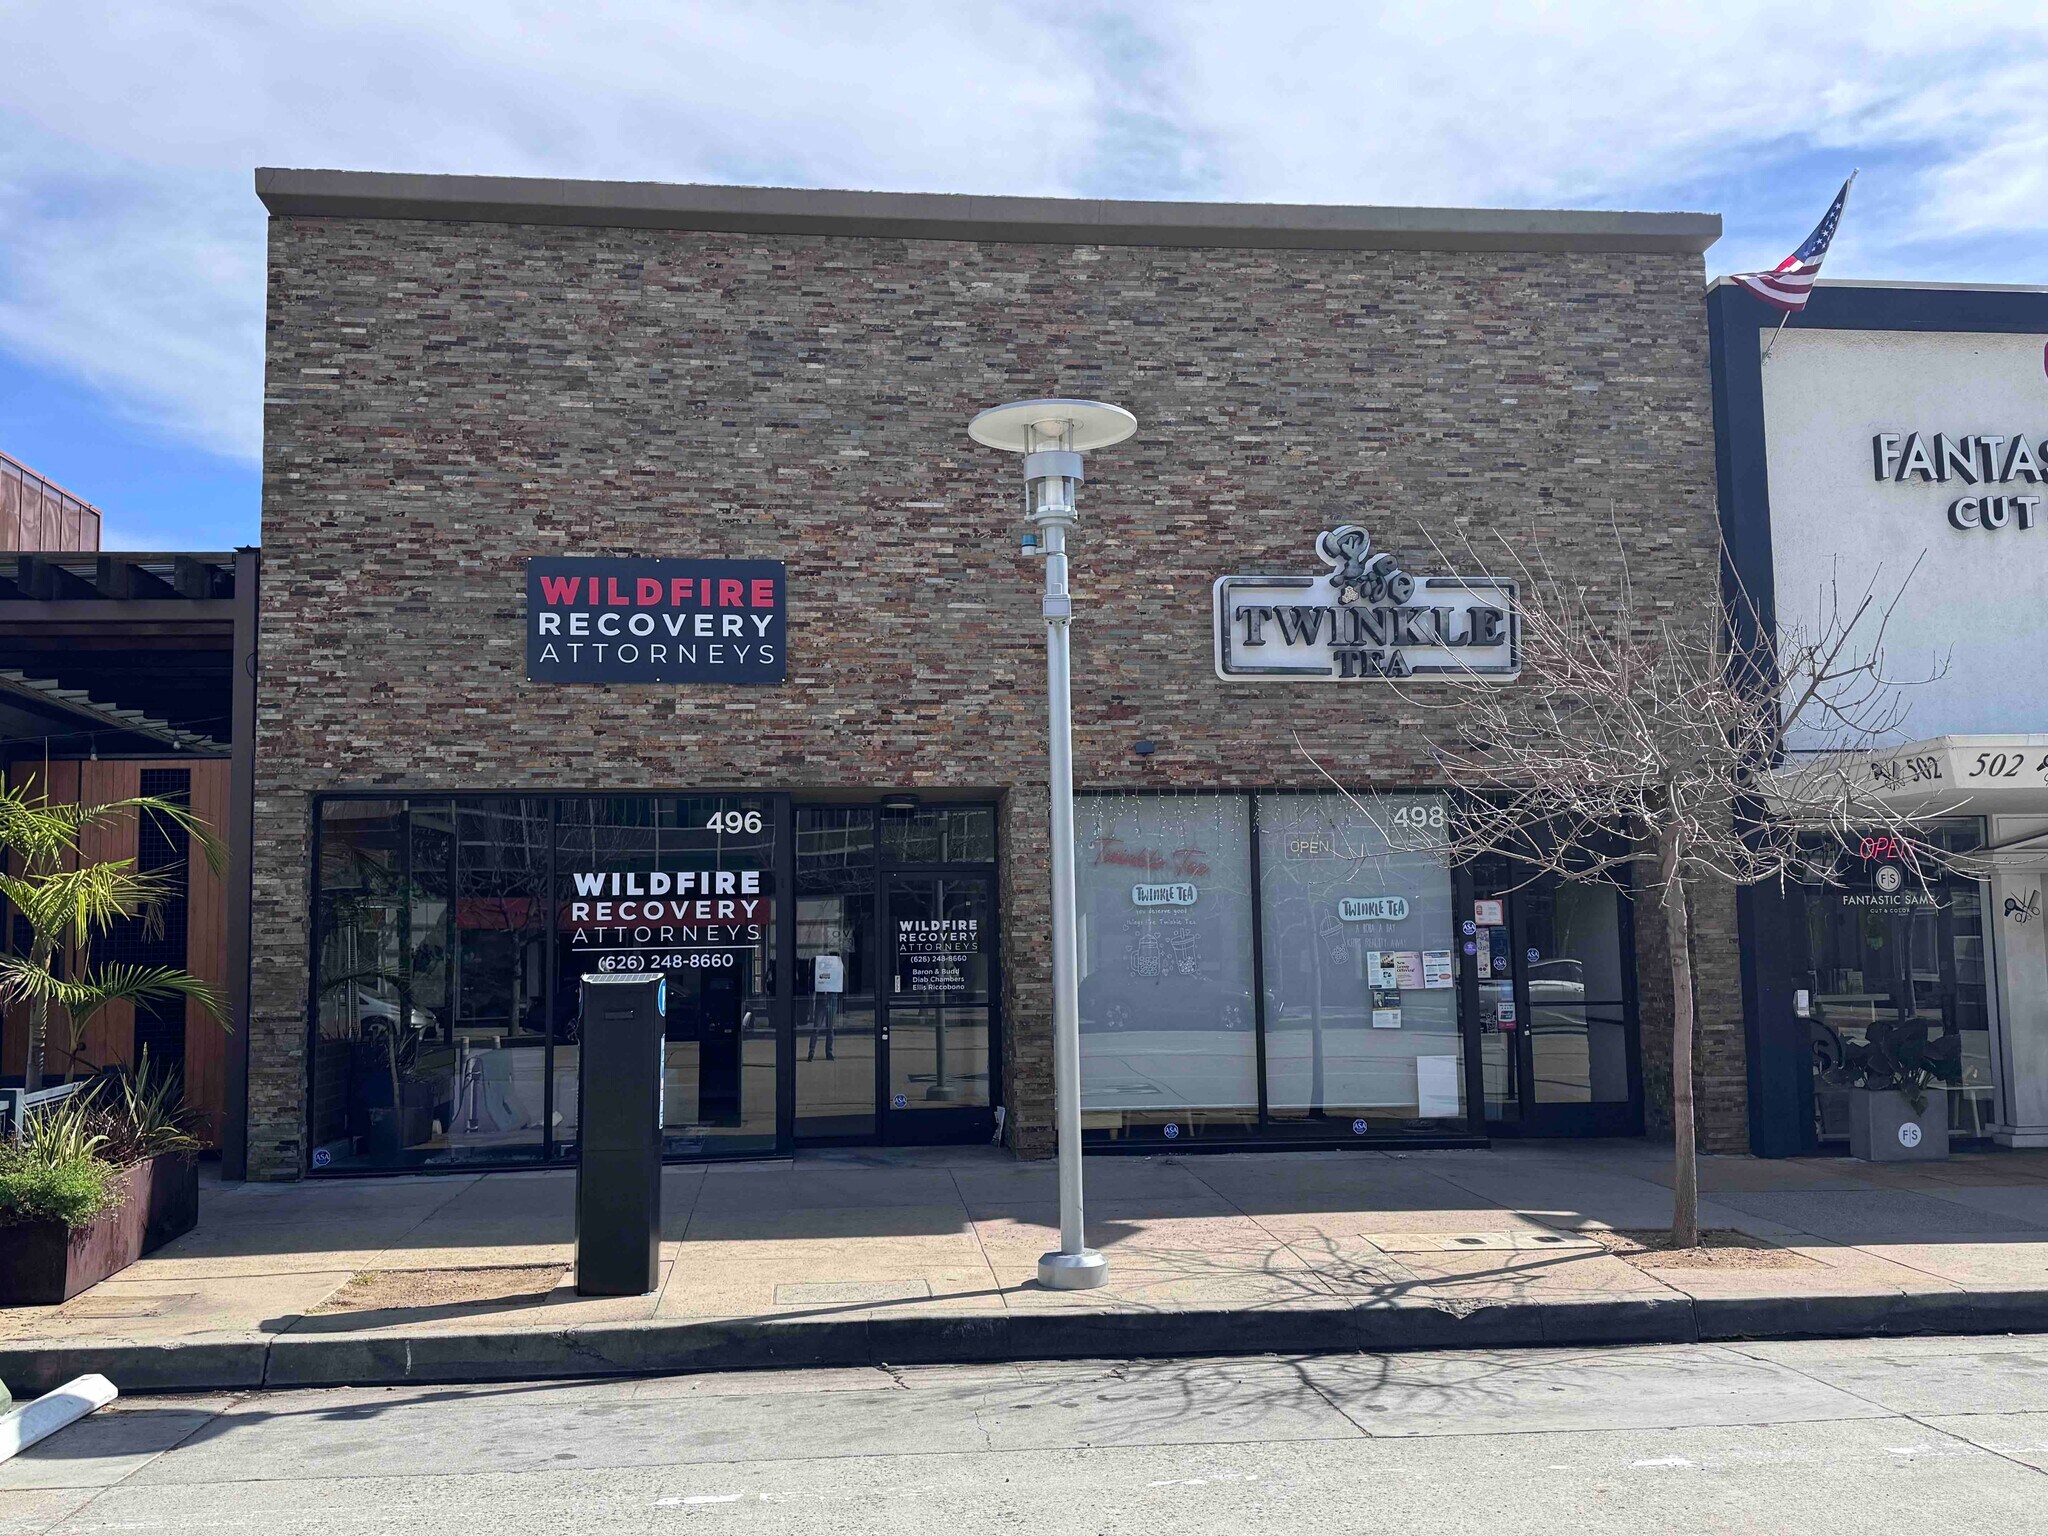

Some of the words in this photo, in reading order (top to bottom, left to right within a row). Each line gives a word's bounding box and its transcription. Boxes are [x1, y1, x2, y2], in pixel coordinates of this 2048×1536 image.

[1872, 431, 2048, 485] FANTA
[1947, 496, 2040, 530] CUT
[540, 576, 774, 608] WILDFIRE
[539, 612, 774, 637] RECOVERY
[1236, 605, 1506, 647] TWINKLE
[539, 643, 775, 664] ATTORNEYS
[1333, 649, 1414, 678] TEA
[1906, 756, 1943, 782] 502
[1968, 753, 2024, 777] 502
[706, 811, 762, 834] 496
[1394, 806, 1444, 828] 498
[1290, 840, 1329, 854] OPEN
[573, 871, 760, 896] WILDFIRE
[1177, 886, 1193, 902] TEA
[572, 900, 759, 921] RECOVERY
[1386, 900, 1405, 917] TEA
[1843, 895, 1901, 905] FANTASTIC
[1905, 895, 1935, 905] SAMS
[572, 925, 760, 944] ATTORNEYS
[899, 920, 978, 932] WILDFIRE
[899, 932, 977, 942] RECOVERY
[900, 942, 978, 952] ATTORNEYS
[598, 955, 645, 972] (626)
[650, 953, 734, 969] 248-8660
[932, 955, 967, 963] 248-8660
